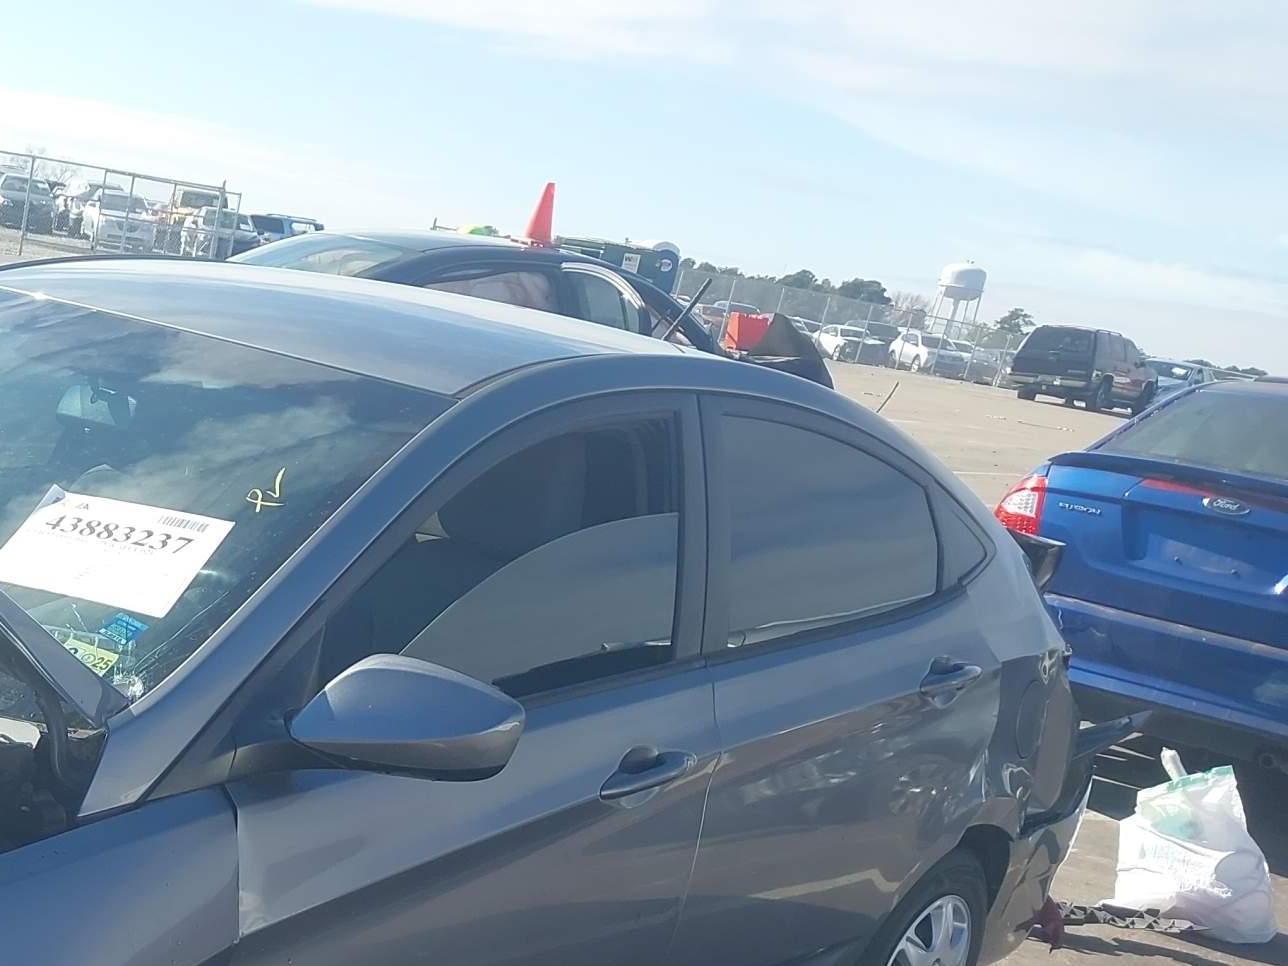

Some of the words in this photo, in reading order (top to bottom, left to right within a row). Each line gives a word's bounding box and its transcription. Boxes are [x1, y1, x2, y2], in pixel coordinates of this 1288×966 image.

[1213, 499, 1241, 511] Ford
[45, 514, 195, 554] 43883237
[91, 656, 113, 671] 25
